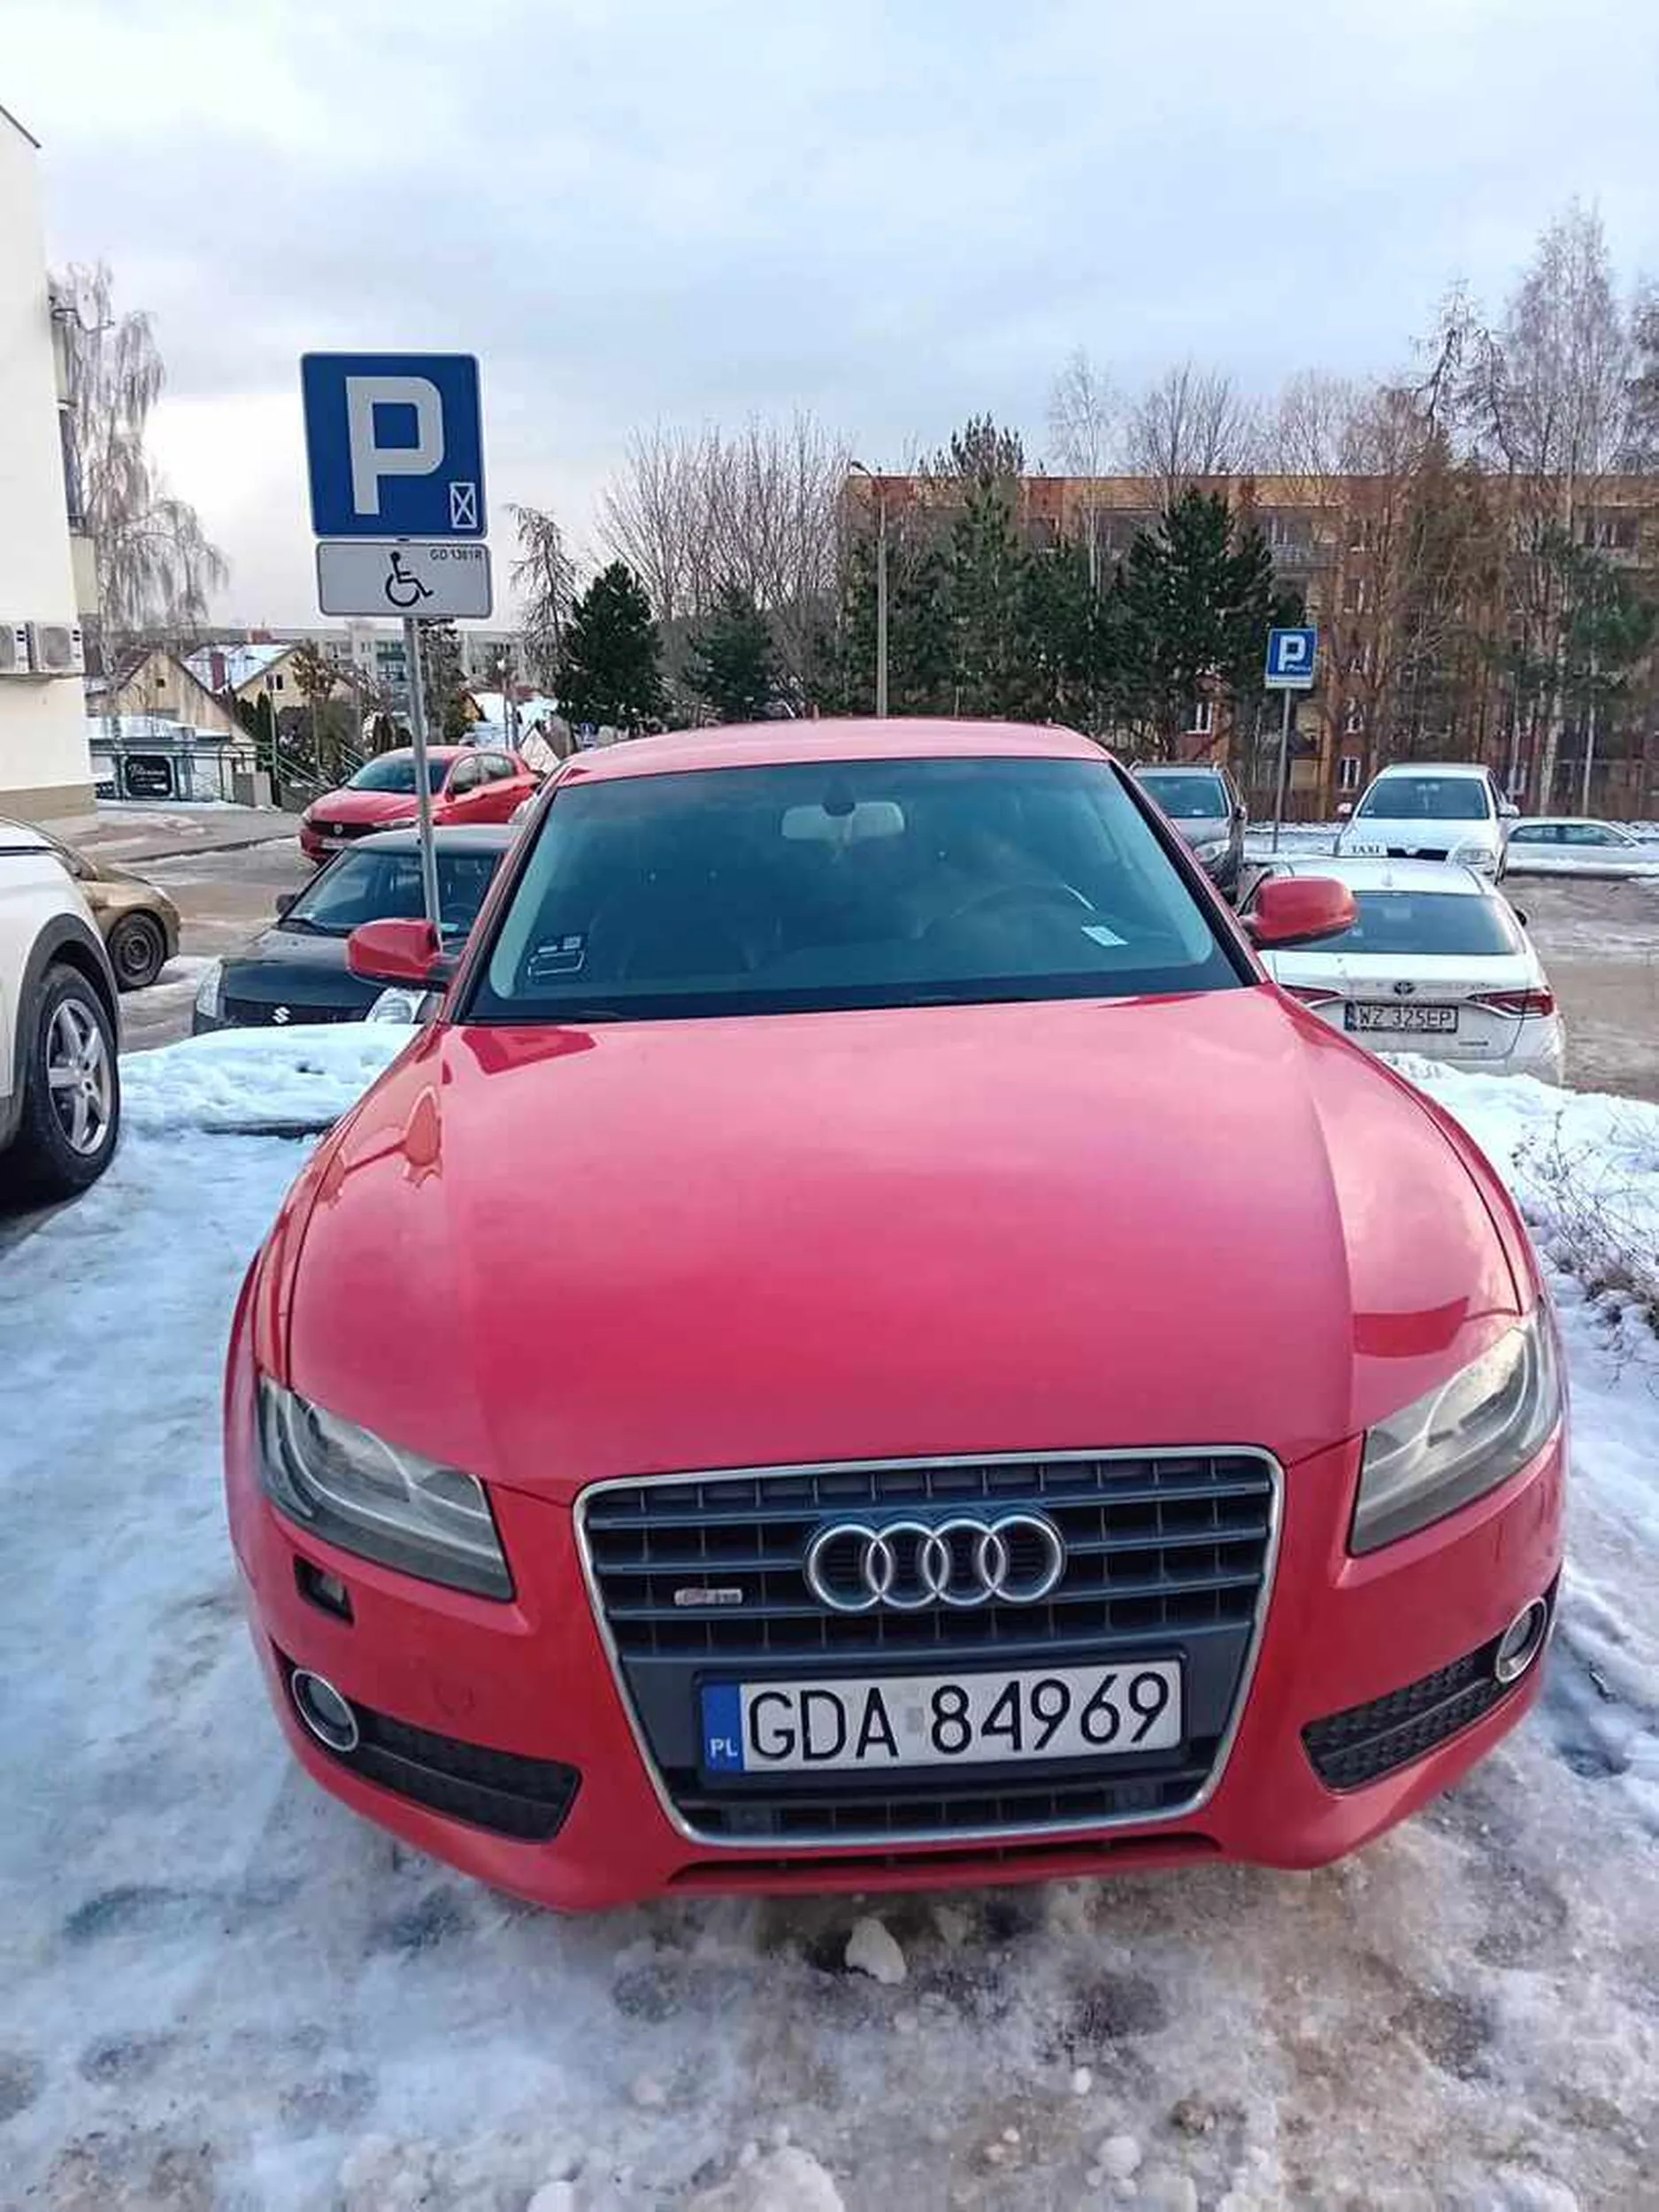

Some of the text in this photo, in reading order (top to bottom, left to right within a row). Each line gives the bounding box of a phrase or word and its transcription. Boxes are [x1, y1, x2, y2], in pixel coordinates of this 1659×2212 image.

[345, 376, 444, 515] P
[1278, 634, 1306, 672] P
[1350, 844, 1380, 854] TAXI
[1359, 1007, 1452, 1028] WZ 325EP
[749, 1671, 1170, 1762] GDA 84969
[710, 1738, 738, 1758] PL
